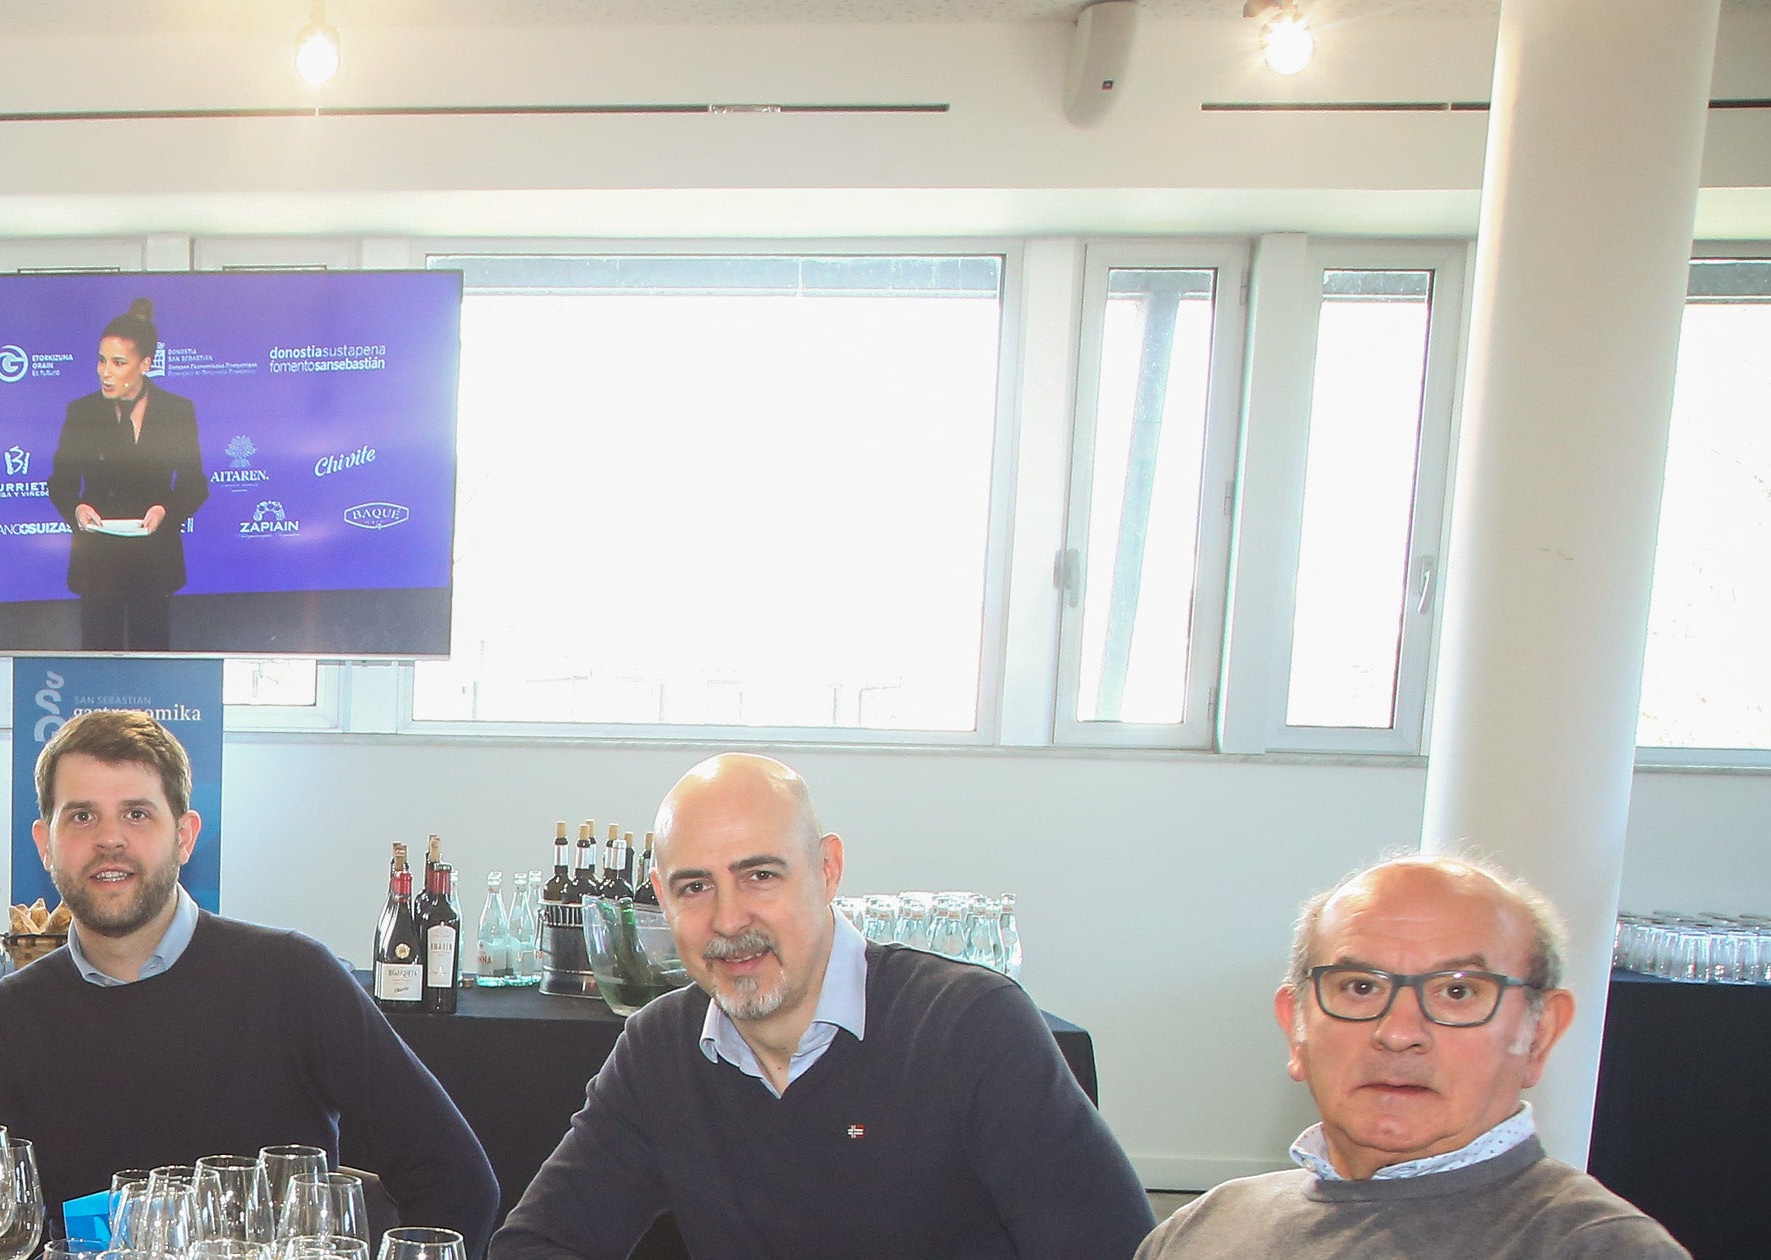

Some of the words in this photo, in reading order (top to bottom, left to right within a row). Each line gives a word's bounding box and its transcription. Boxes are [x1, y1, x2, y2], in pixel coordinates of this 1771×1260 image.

[269, 344, 386, 359] donostiasustapena
[269, 357, 386, 373] fomentosansebastián
[314, 444, 376, 477] Chivite
[239, 520, 299, 533] ZAPIAIN
